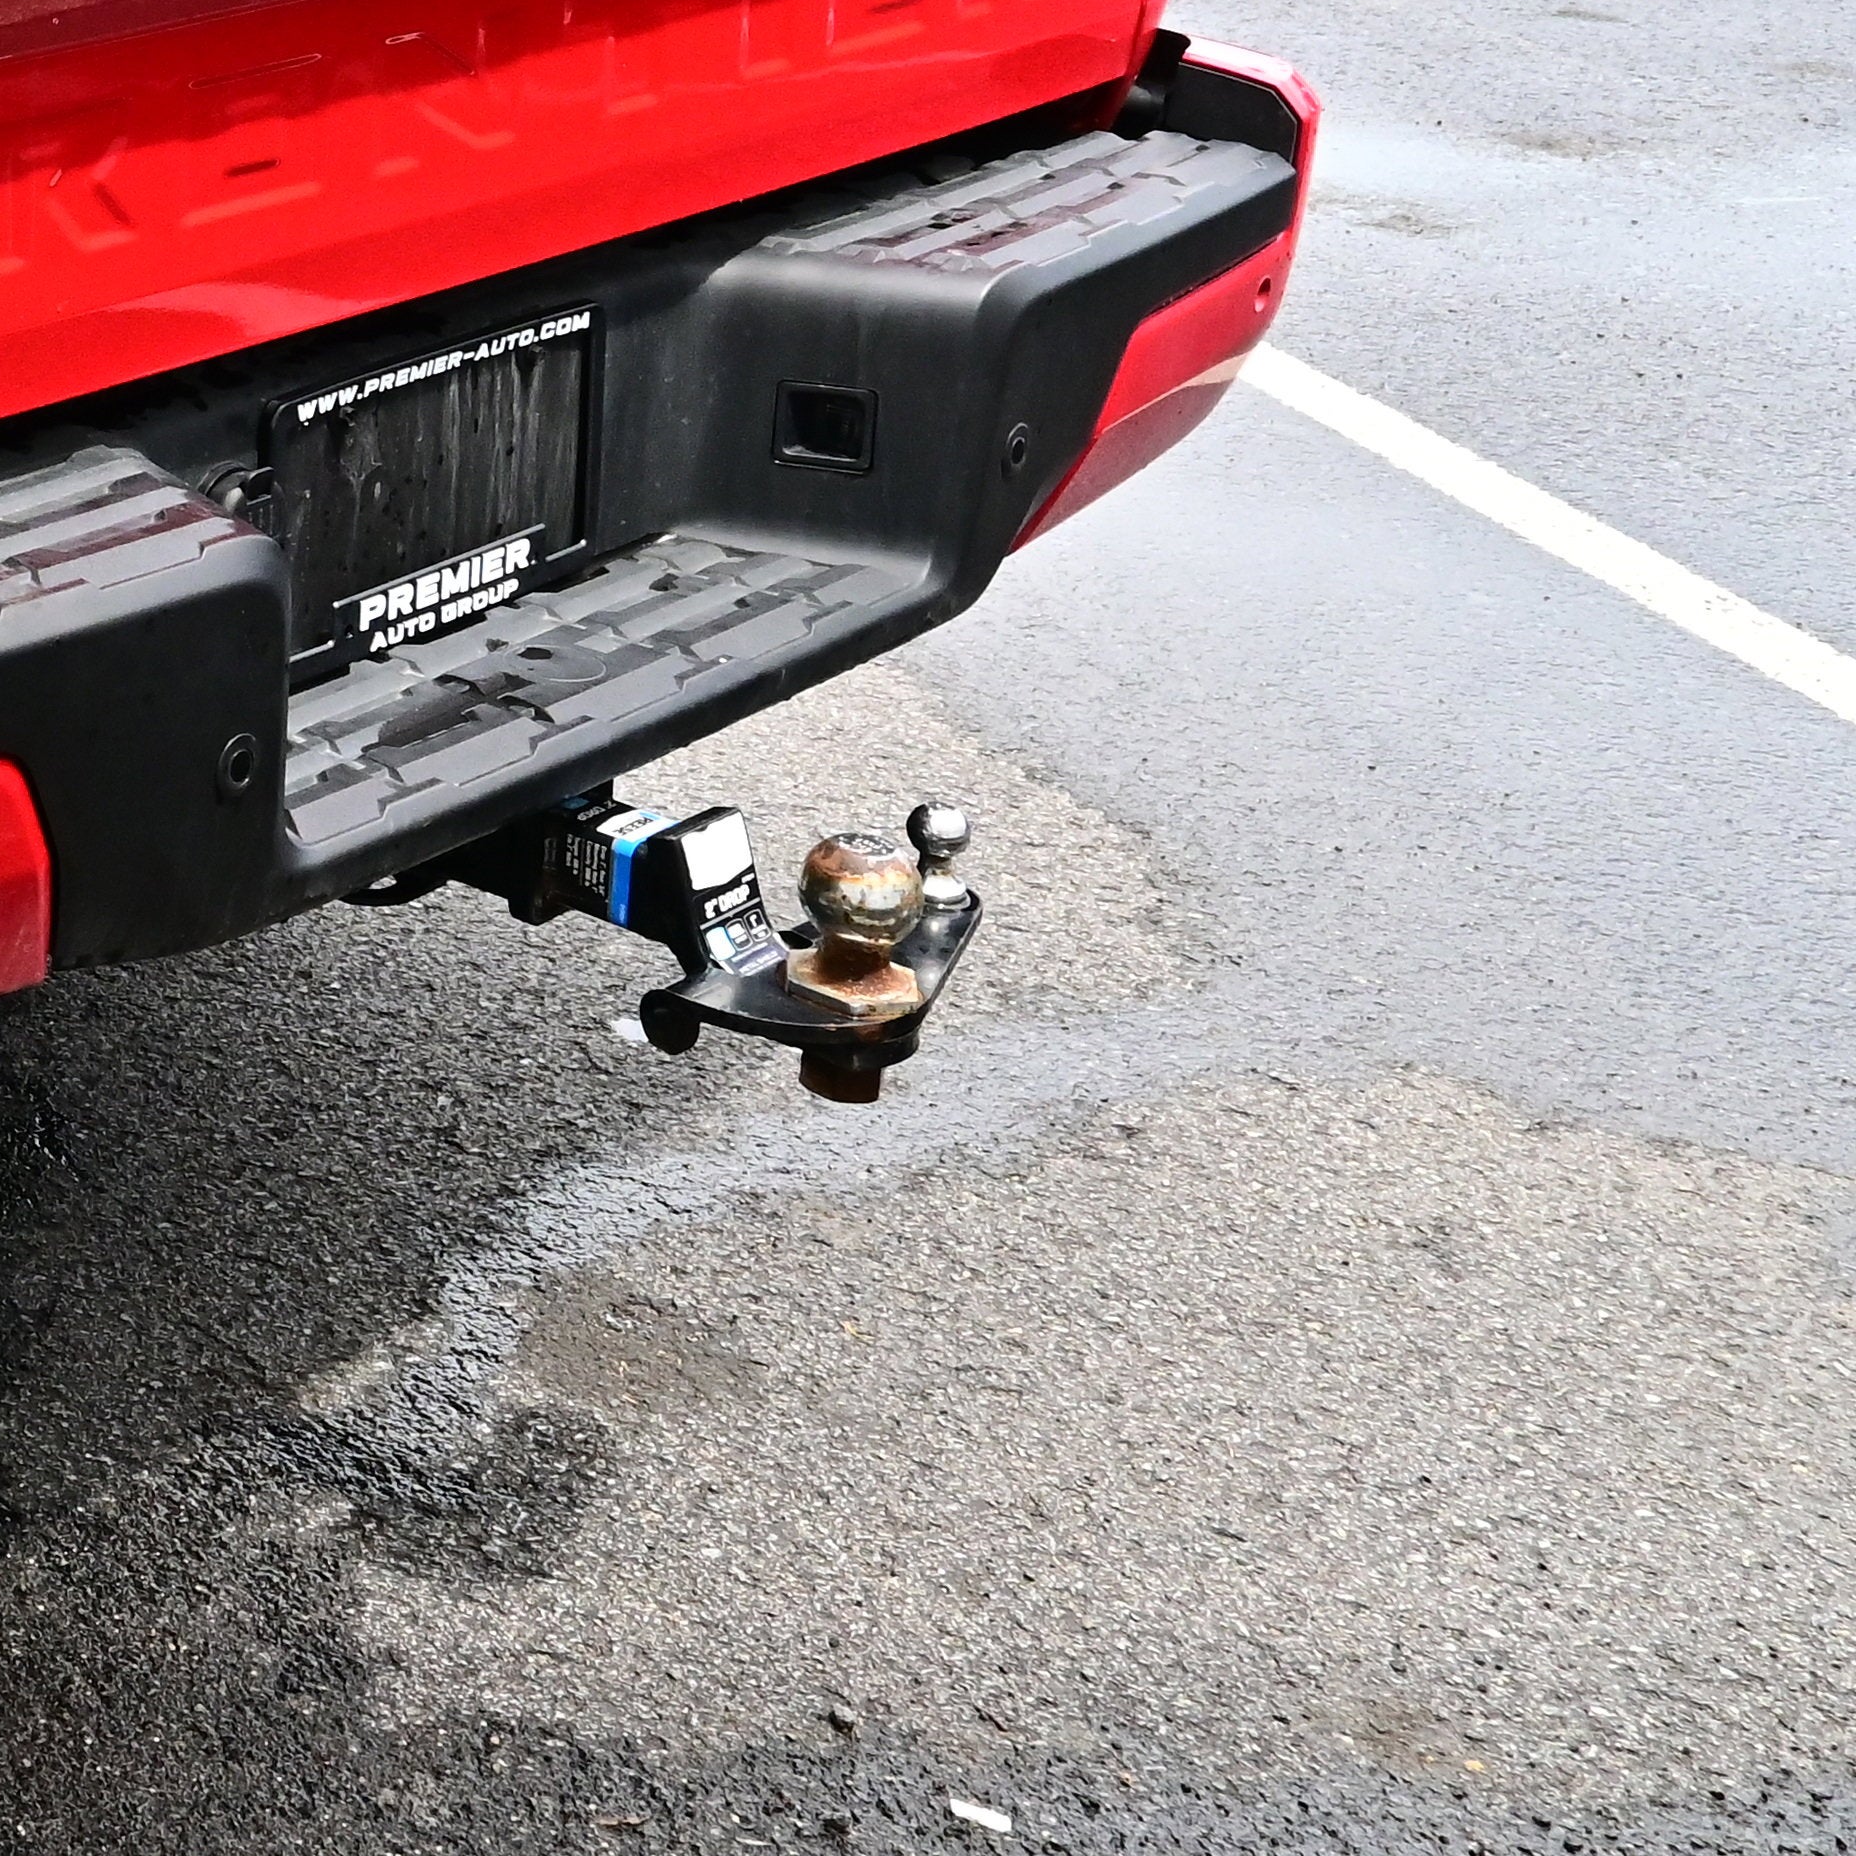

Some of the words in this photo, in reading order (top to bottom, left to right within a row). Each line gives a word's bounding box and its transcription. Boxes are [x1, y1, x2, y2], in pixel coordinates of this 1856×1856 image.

[297, 311, 590, 423] WWW.PREMIER-AUTO.COM
[359, 538, 532, 632] PREMIER
[369, 613, 436, 652] AUTO
[440, 578, 520, 625] GROUP
[717, 883, 750, 912] DROP
